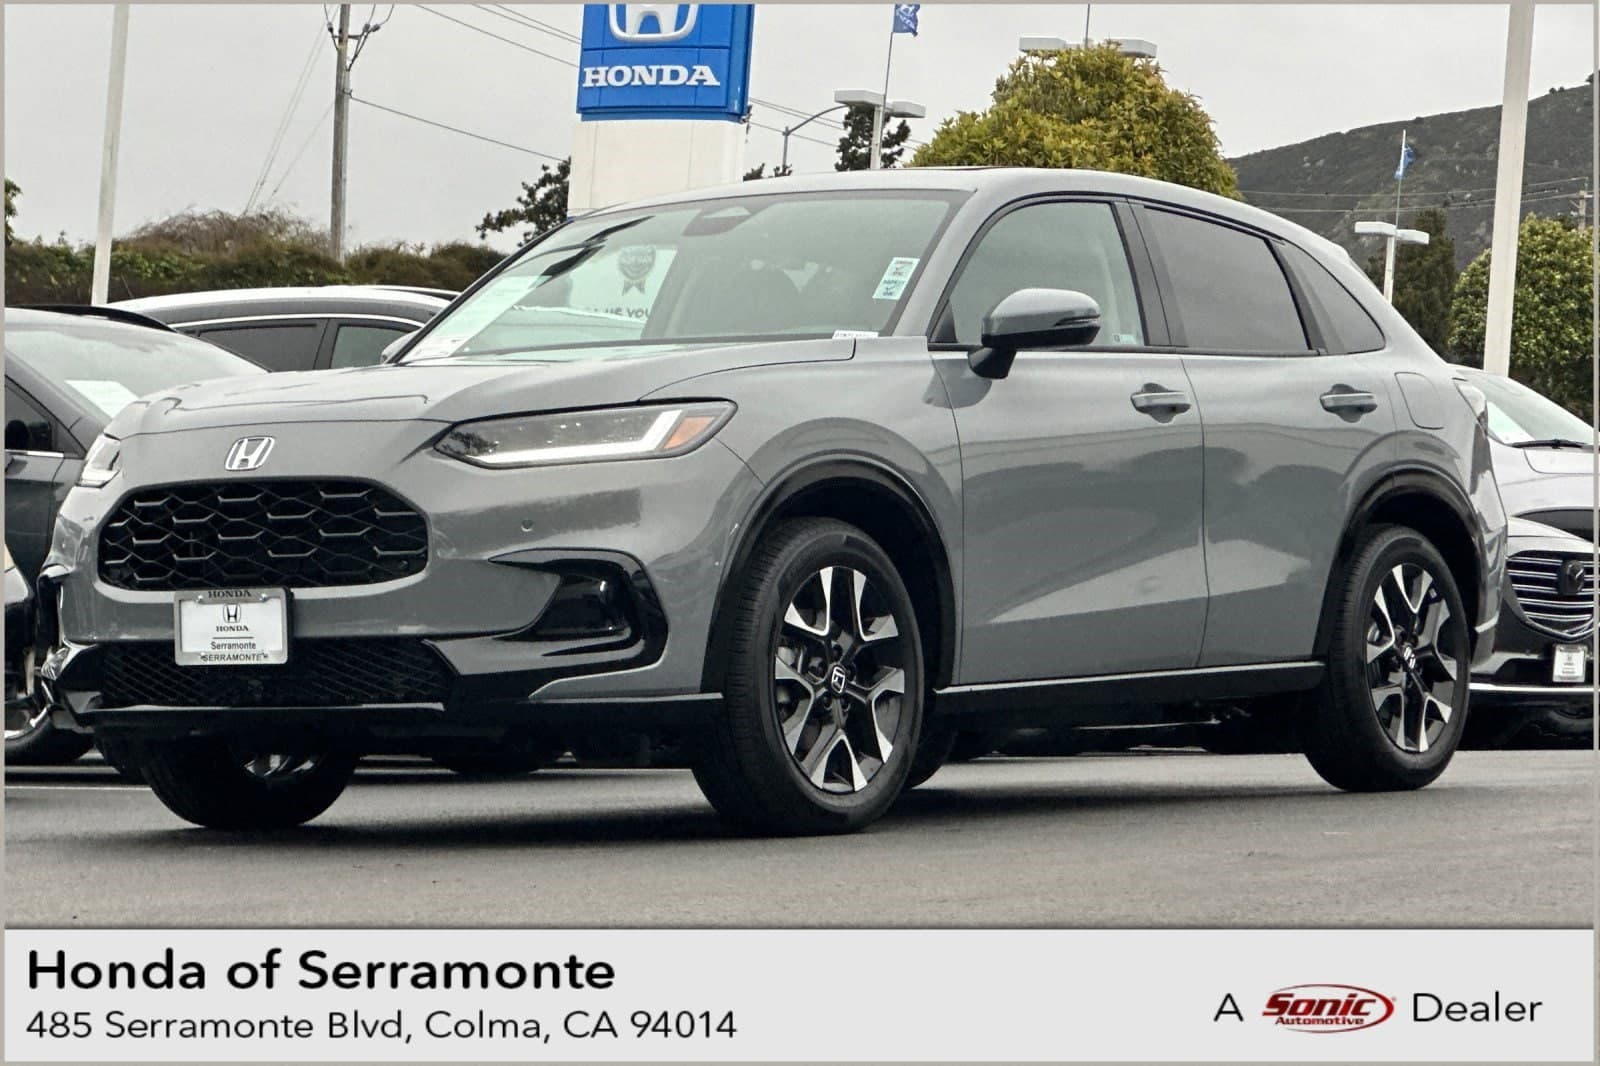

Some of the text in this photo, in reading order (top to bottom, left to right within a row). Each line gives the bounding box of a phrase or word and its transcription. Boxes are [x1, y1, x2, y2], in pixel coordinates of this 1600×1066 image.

[582, 65, 721, 87] HONDA
[208, 590, 252, 598] HONDA
[211, 641, 257, 650] Serramonte
[203, 653, 261, 662] SERRAMONTE
